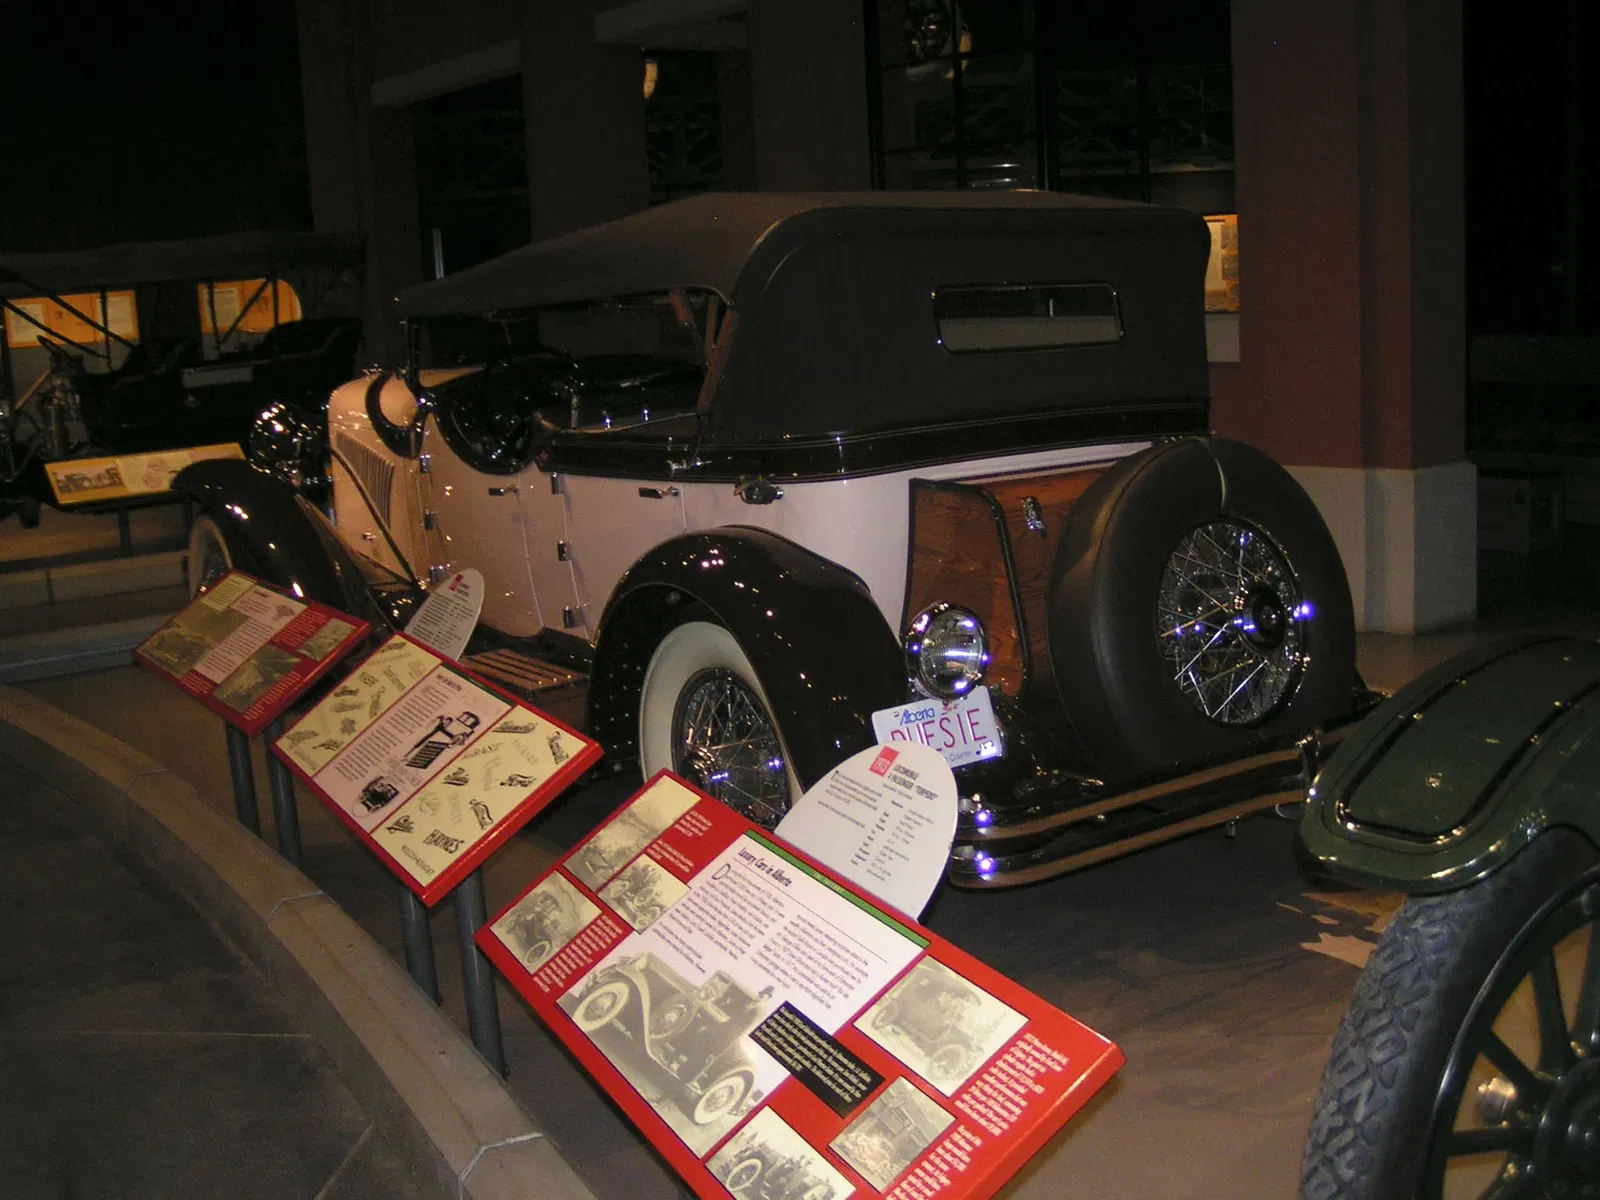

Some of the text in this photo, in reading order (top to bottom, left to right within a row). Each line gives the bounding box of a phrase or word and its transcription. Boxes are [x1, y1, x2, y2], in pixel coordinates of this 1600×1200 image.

[900, 707, 936, 726] Alberta
[423, 829, 465, 854] HAYNES
[738, 847, 792, 887] Luxury Cars in Alberta
